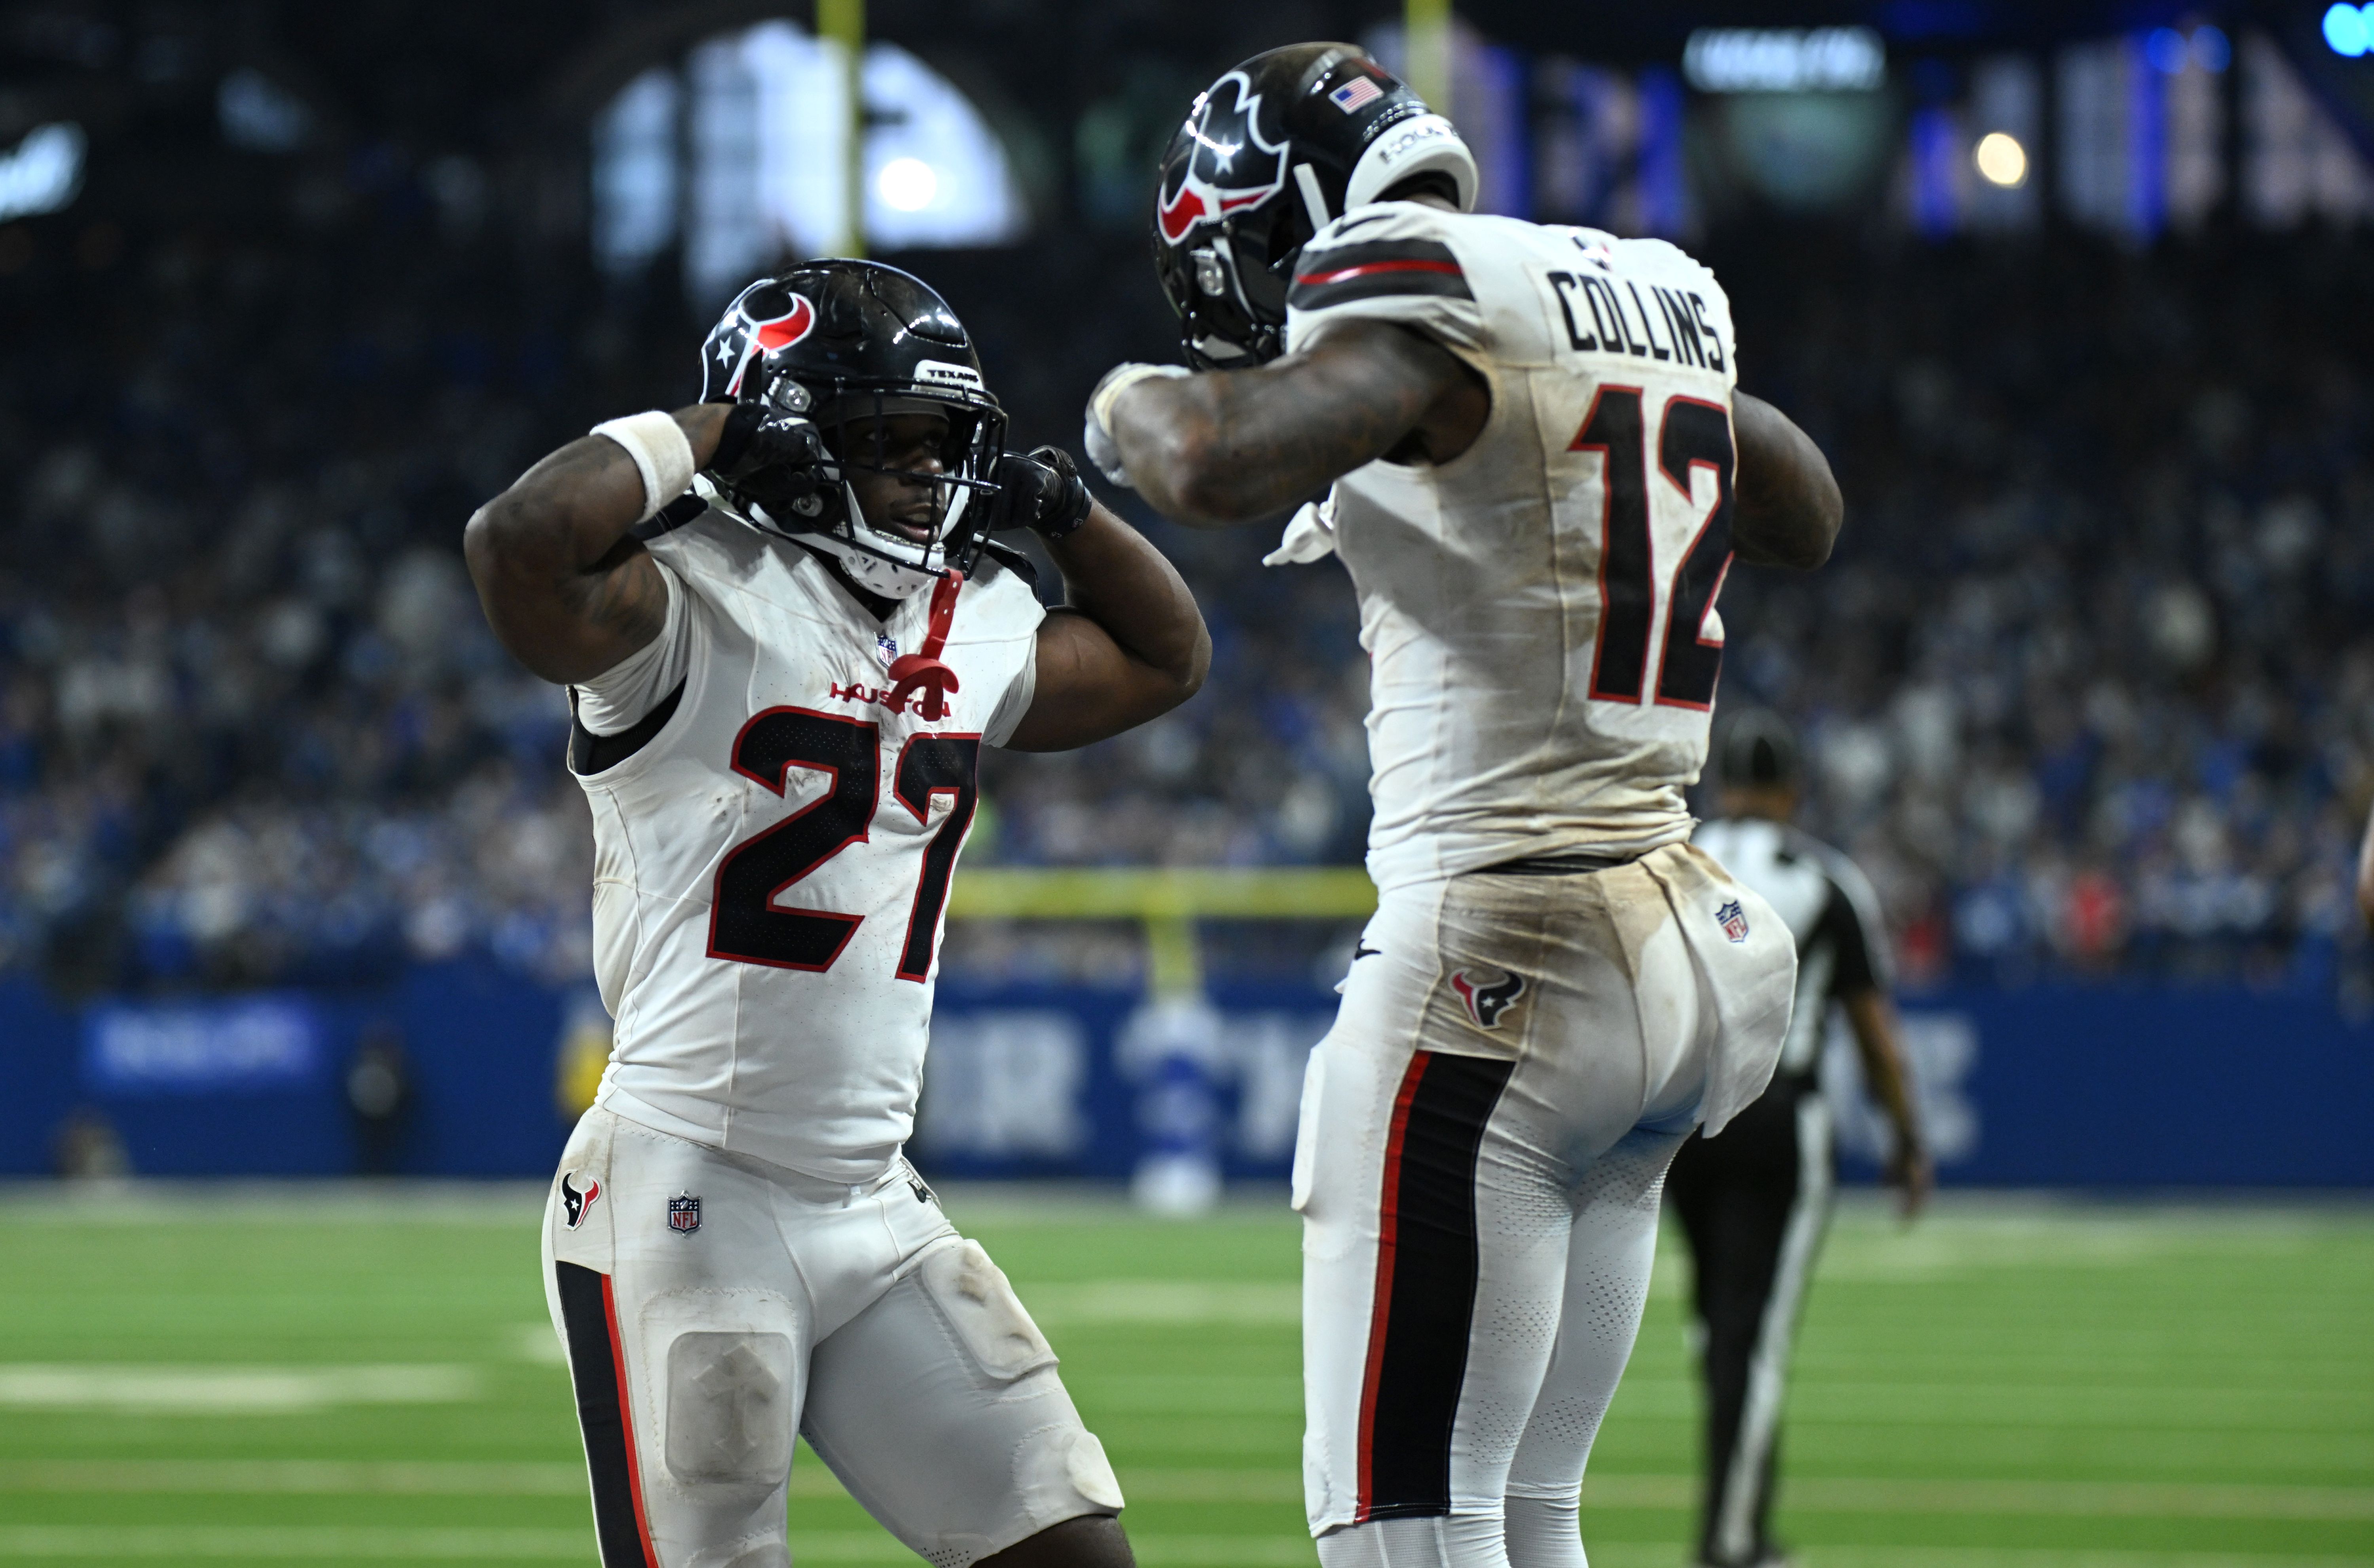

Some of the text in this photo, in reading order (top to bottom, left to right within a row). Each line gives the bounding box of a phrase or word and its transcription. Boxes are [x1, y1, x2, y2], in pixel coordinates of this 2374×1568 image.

[1546, 270, 1726, 373] COLLINS
[1567, 384, 1736, 711] 12
[706, 705, 982, 983] 27
[673, 1212, 697, 1229] NFL
